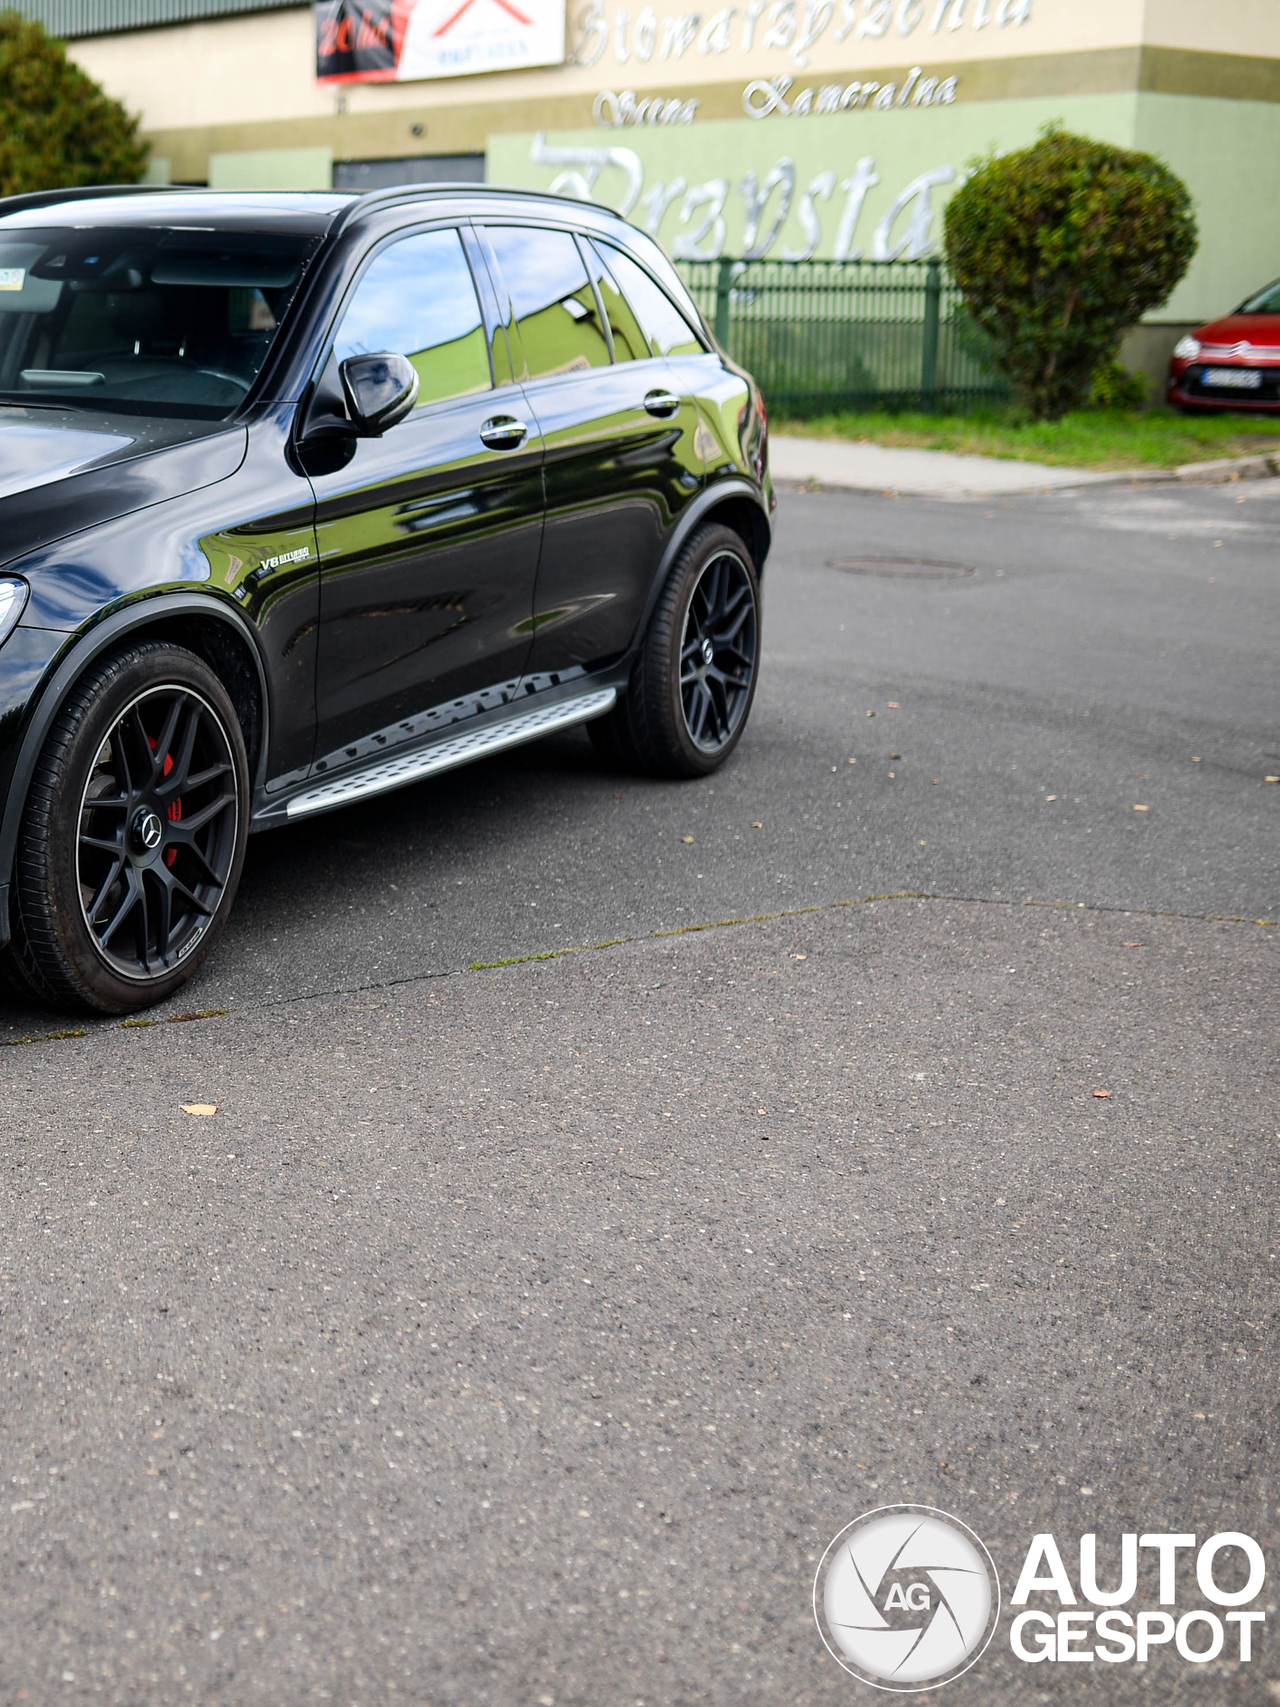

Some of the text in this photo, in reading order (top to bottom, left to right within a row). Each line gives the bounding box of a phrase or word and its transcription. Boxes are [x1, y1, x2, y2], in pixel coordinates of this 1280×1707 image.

[742, 66, 959, 119] Kameralna
[530, 130, 1008, 303] Przysta
[260, 556, 279, 570] V8
